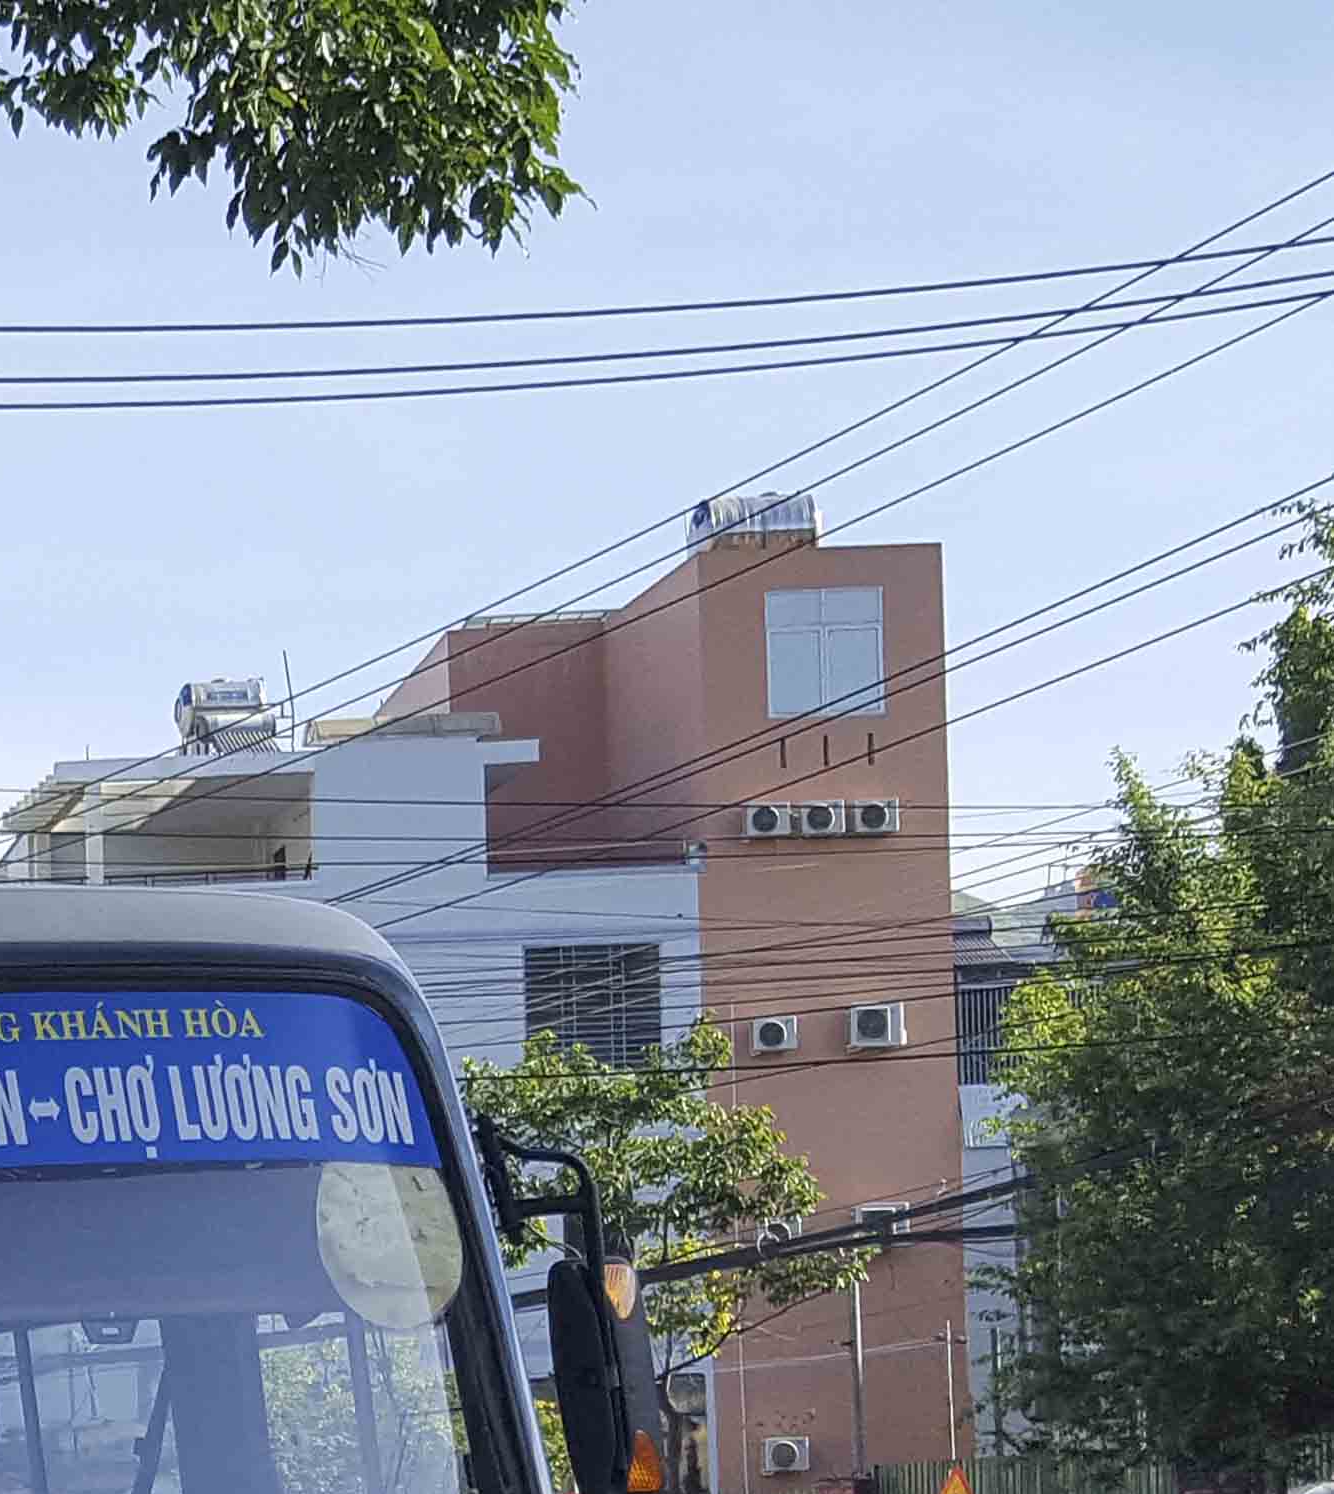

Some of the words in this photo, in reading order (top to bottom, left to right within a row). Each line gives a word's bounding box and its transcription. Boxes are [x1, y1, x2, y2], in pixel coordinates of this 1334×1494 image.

[30, 1001, 173, 1041] KHÁNH
[181, 999, 265, 1040] HÒA
[63, 1054, 161, 1159] CHỢ
[167, 1053, 321, 1142] LƯƠNG
[324, 1058, 415, 1145] SƠN
